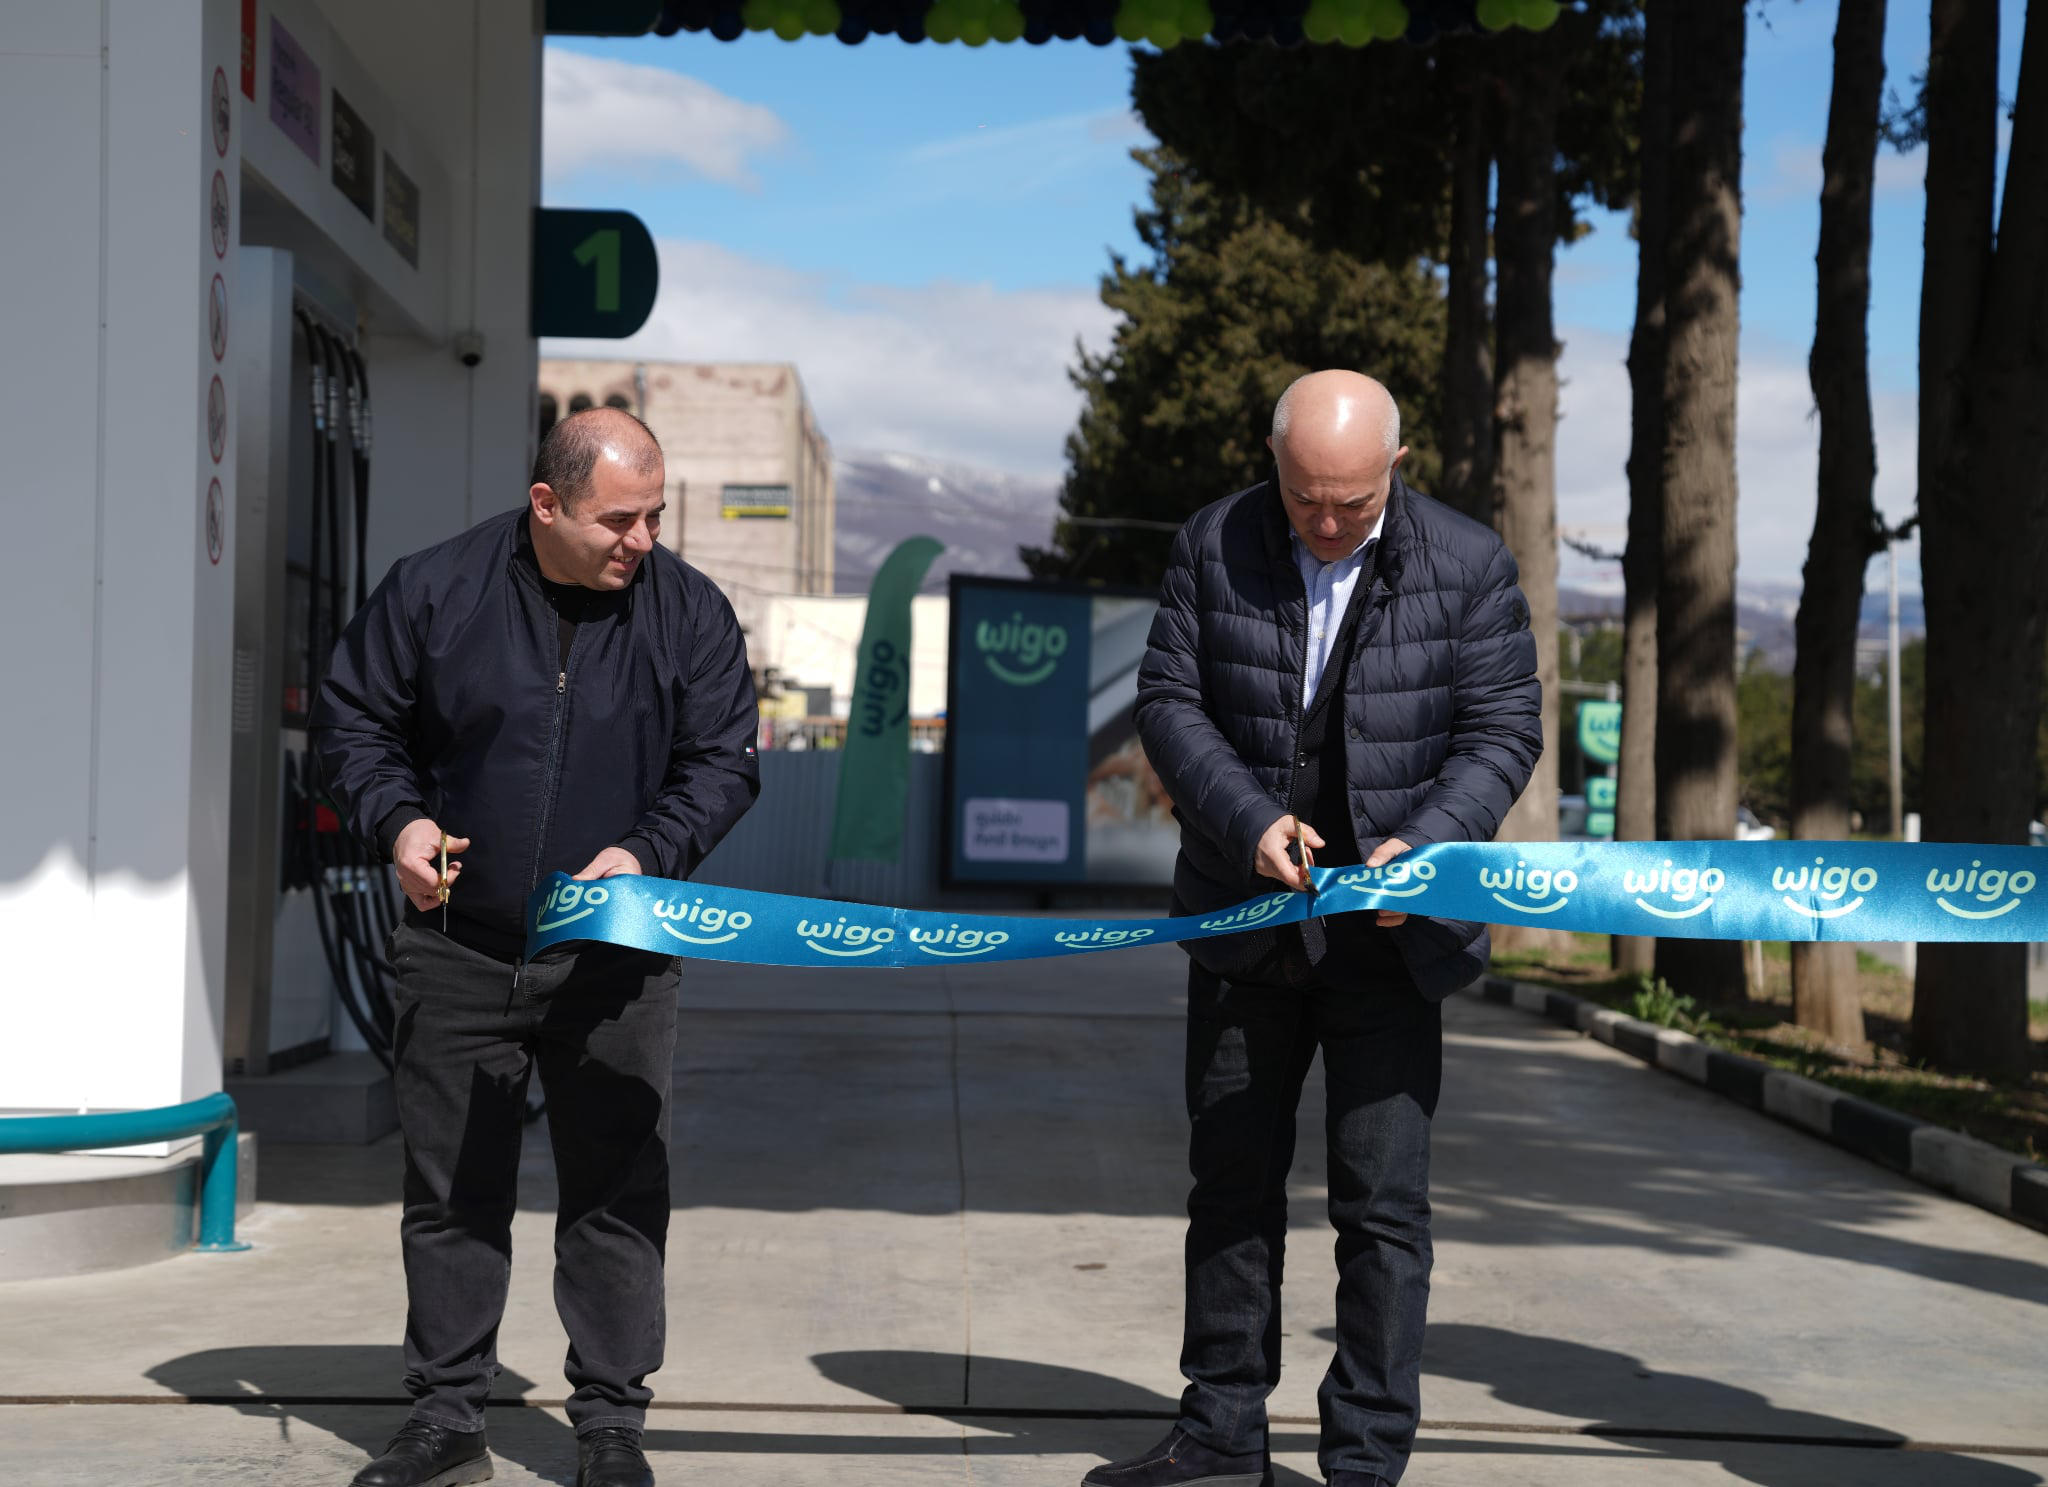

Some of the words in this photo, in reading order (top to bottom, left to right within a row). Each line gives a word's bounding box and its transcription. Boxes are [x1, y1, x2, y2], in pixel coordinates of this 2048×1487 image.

[573, 230, 620, 311] 1
[977, 611, 1068, 664] wigo
[862, 639, 898, 738] wigo
[1337, 860, 1437, 885] wigo
[1479, 860, 1579, 900] wigo
[1623, 859, 1725, 901] wigo
[1772, 856, 1878, 900] wigo
[1926, 859, 2036, 902] wigo
[653, 898, 752, 932] wigo
[1200, 892, 1295, 929] wigo
[796, 917, 895, 945] wigo
[909, 923, 1009, 949] wigo
[1054, 927, 1155, 943] wigo
